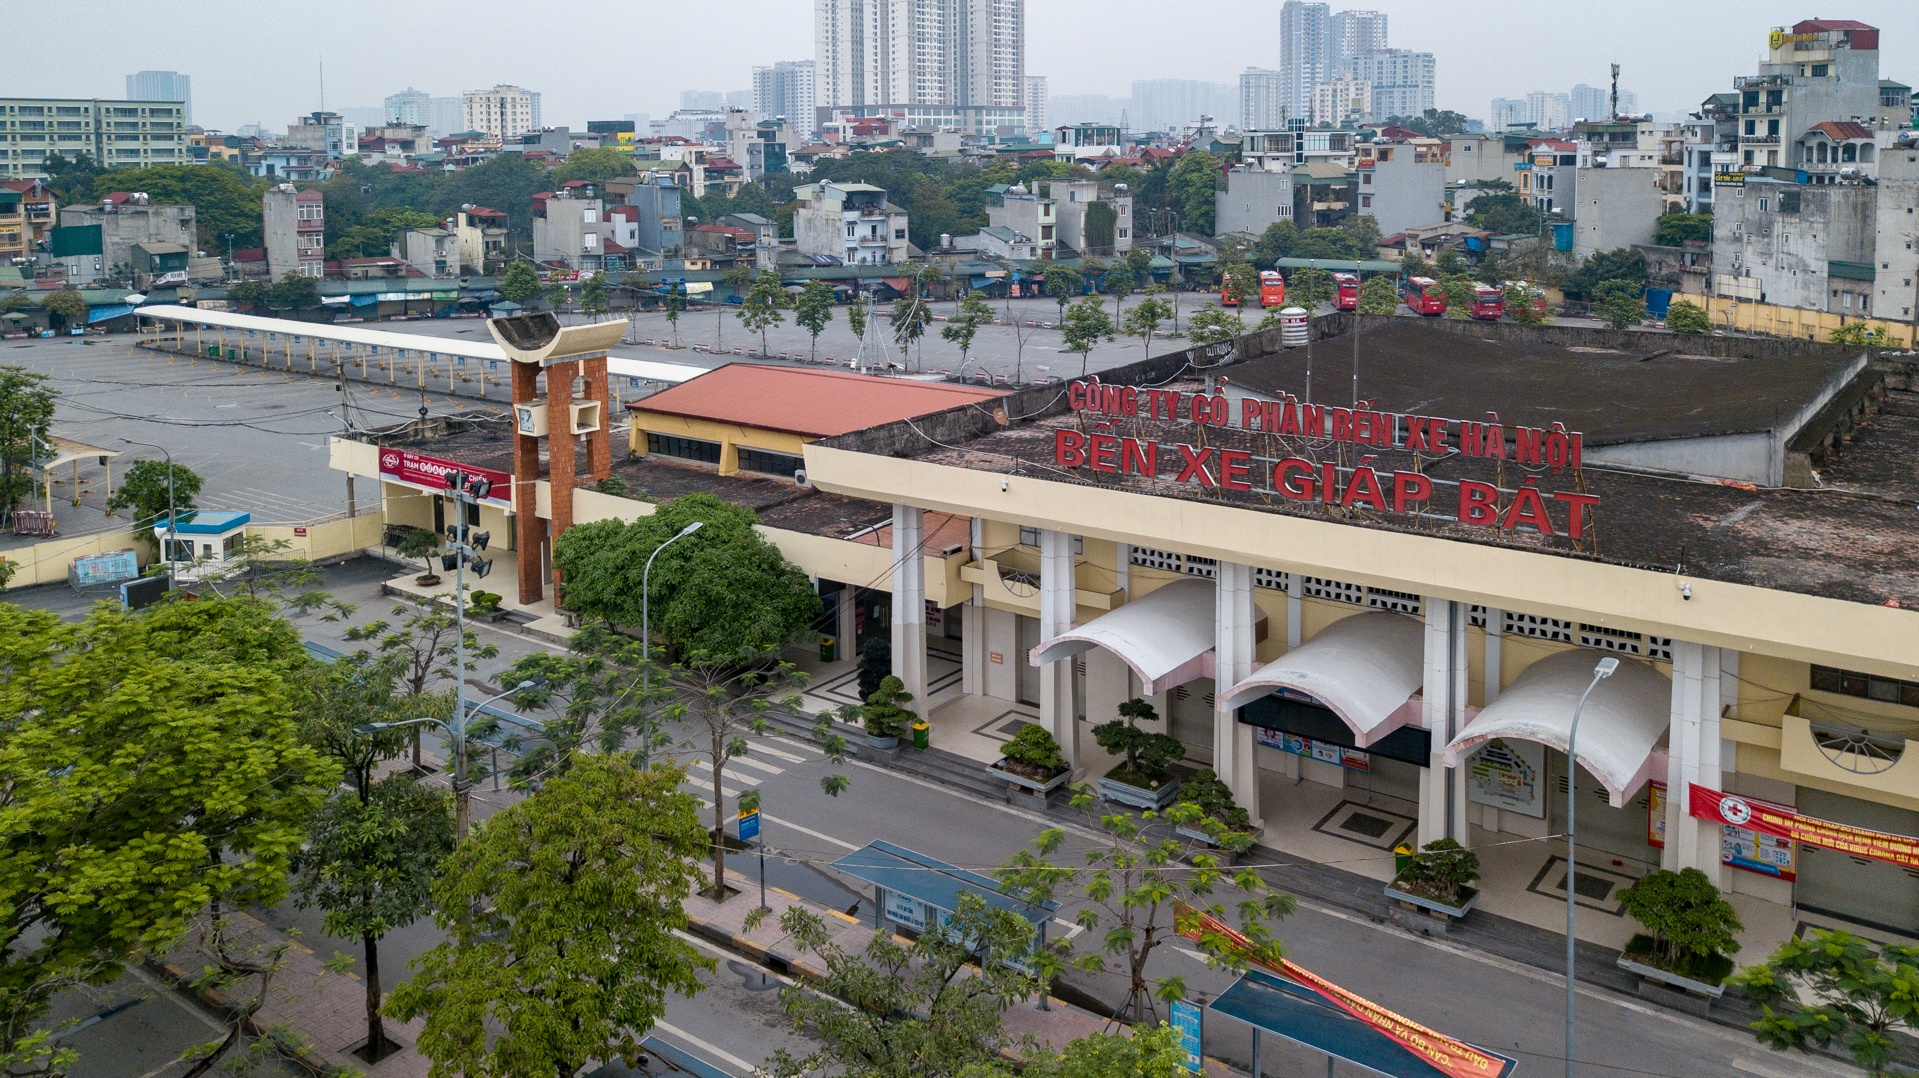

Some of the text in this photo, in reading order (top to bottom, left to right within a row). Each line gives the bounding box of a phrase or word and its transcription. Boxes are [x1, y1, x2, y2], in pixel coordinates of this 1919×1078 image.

[1069, 375, 1582, 474] CÔNG TY CỔ PHẦN BẾN XE HÀ NỘI
[1055, 420, 1600, 540] BẾN XE GIÁP BÁT
[1762, 813, 1783, 825] CHUNG
[1784, 819, 1793, 828] TAY
[1849, 843, 1868, 855] VIRUS
[1869, 848, 1895, 860] CORONA
[1910, 857, 1919, 866] RA
